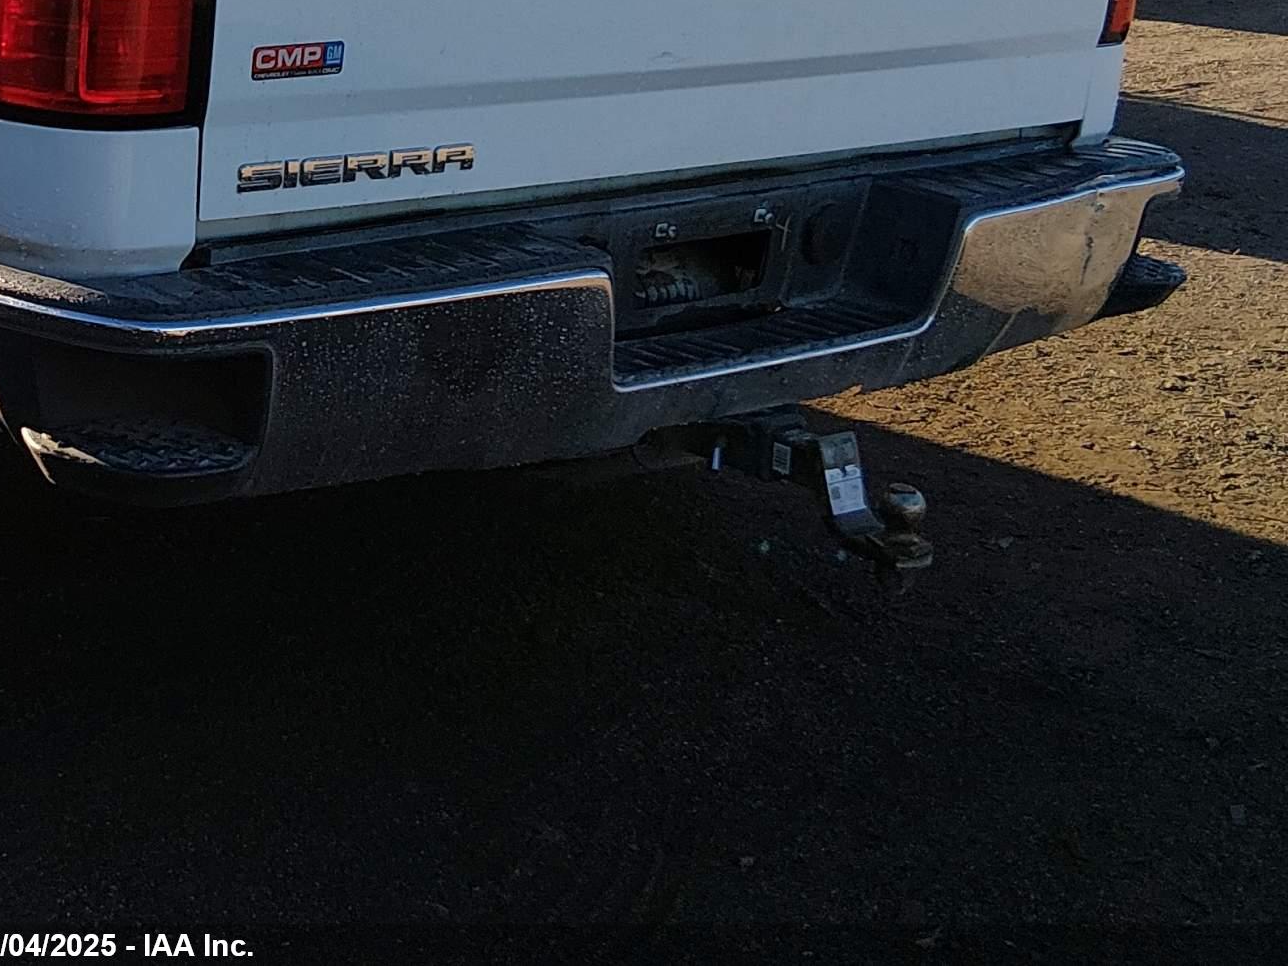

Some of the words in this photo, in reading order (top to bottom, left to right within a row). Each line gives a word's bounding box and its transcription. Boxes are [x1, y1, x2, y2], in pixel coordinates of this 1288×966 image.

[255, 46, 322, 69] CMP
[326, 44, 342, 61] GM
[236, 143, 475, 194] SIERRA
